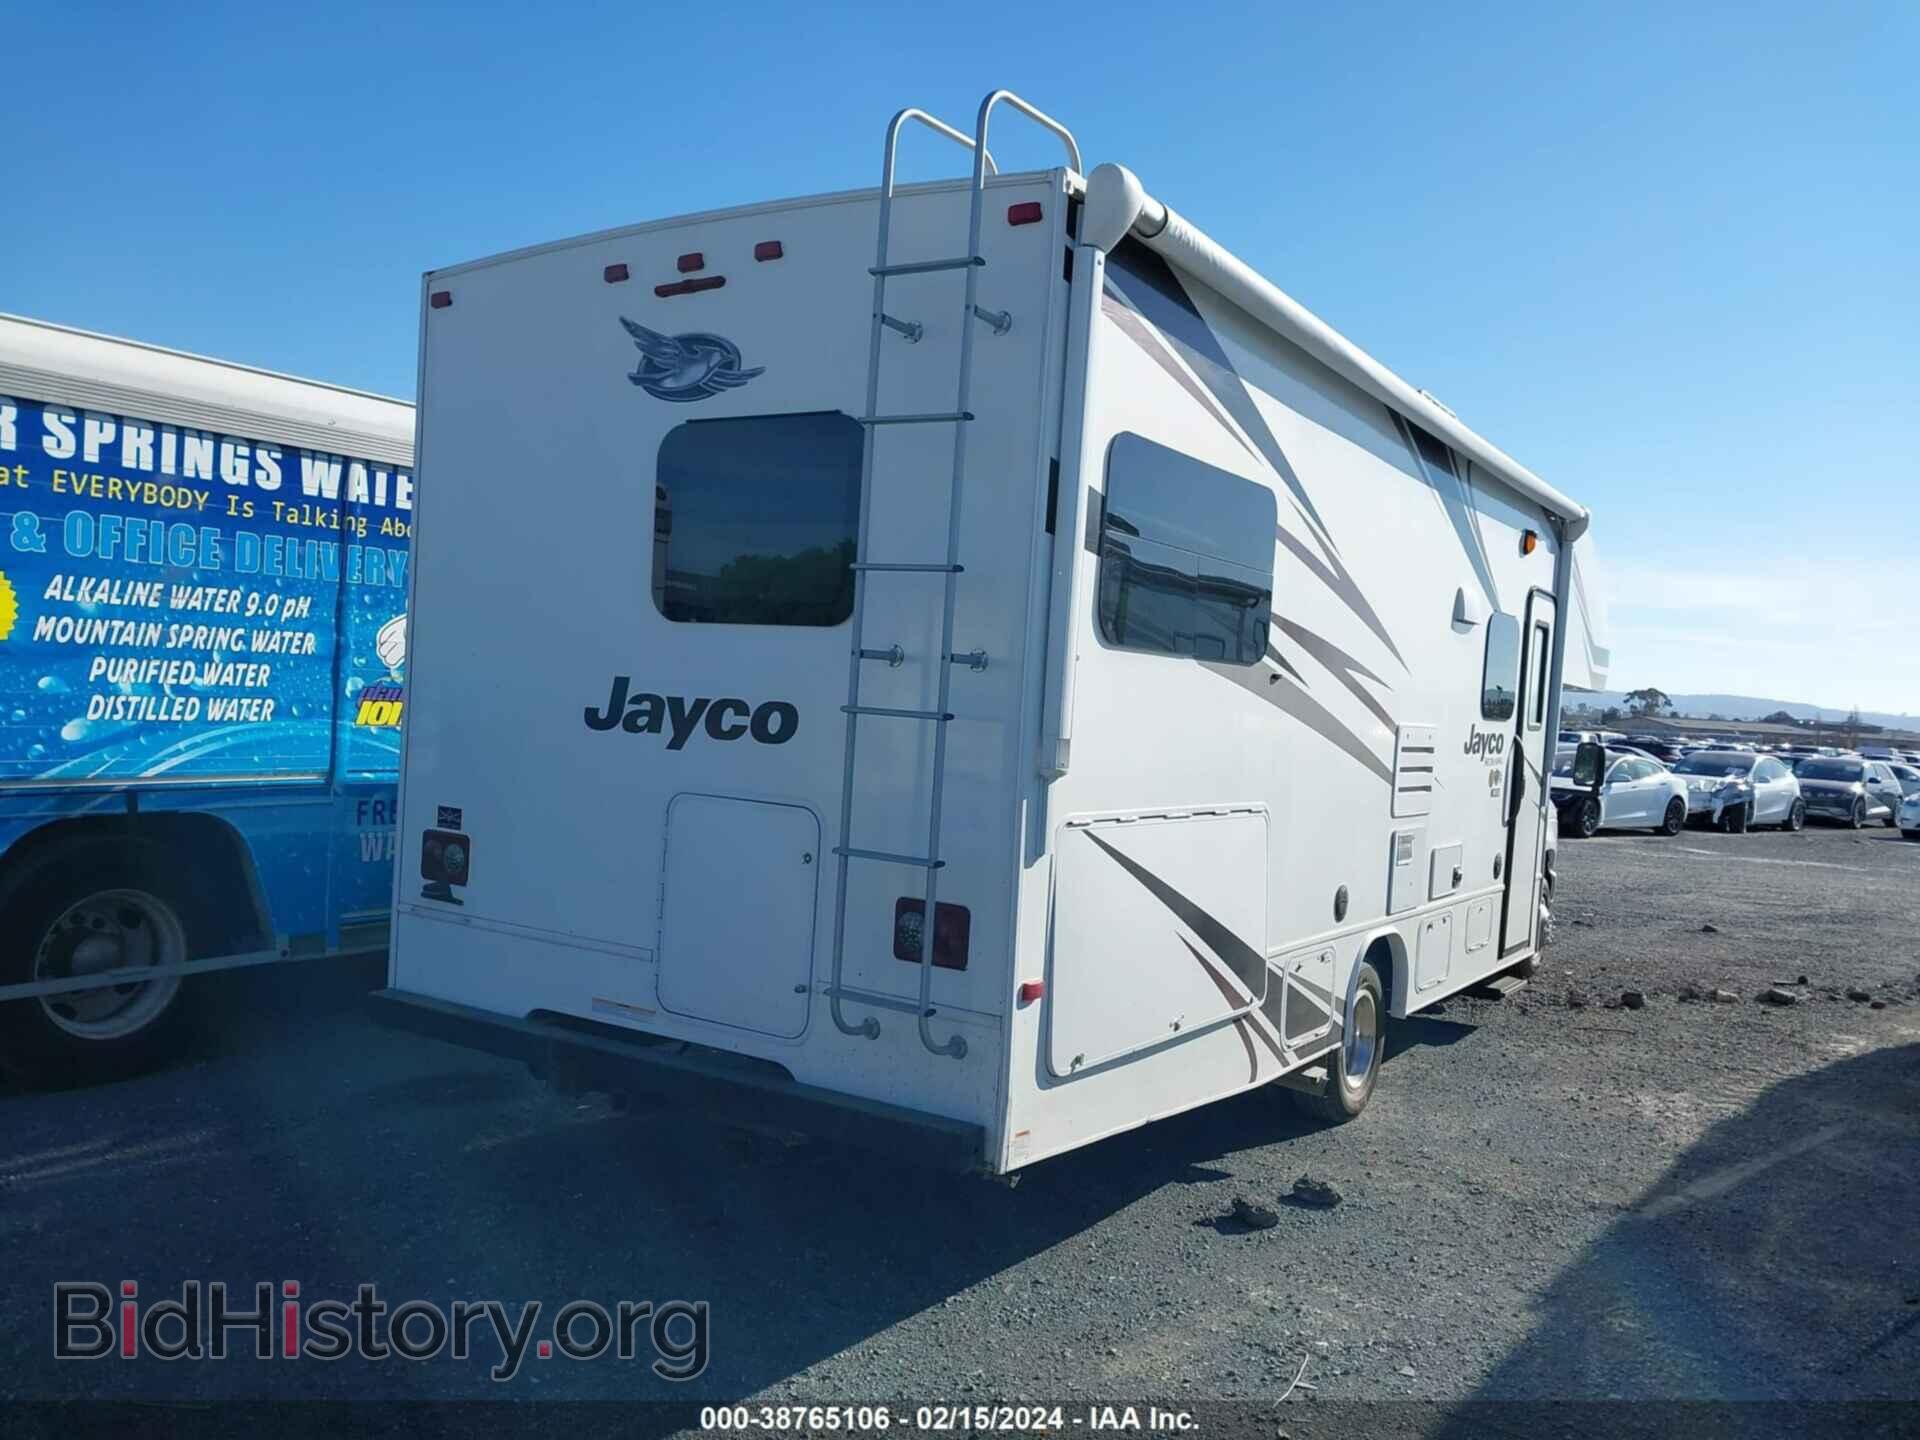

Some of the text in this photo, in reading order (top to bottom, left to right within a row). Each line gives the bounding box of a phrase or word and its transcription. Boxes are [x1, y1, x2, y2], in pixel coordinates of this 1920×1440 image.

[42, 404, 283, 490] SPRINGS
[53, 469, 210, 511] EVERYBODY
[226, 495, 255, 518] Is
[272, 502, 367, 538] Talking
[10, 510, 409, 588] & OFFICE DELIVERY
[43, 574, 311, 623] ALKALINE WATER 9.0 pH
[33, 615, 317, 655] MOUNTAIN SPRING WATER
[89, 656, 271, 688] PURIFIED WATER
[87, 694, 275, 722] DISTILLED WATER
[584, 676, 799, 751] Jayco
[1463, 723, 1504, 763] Jayco
